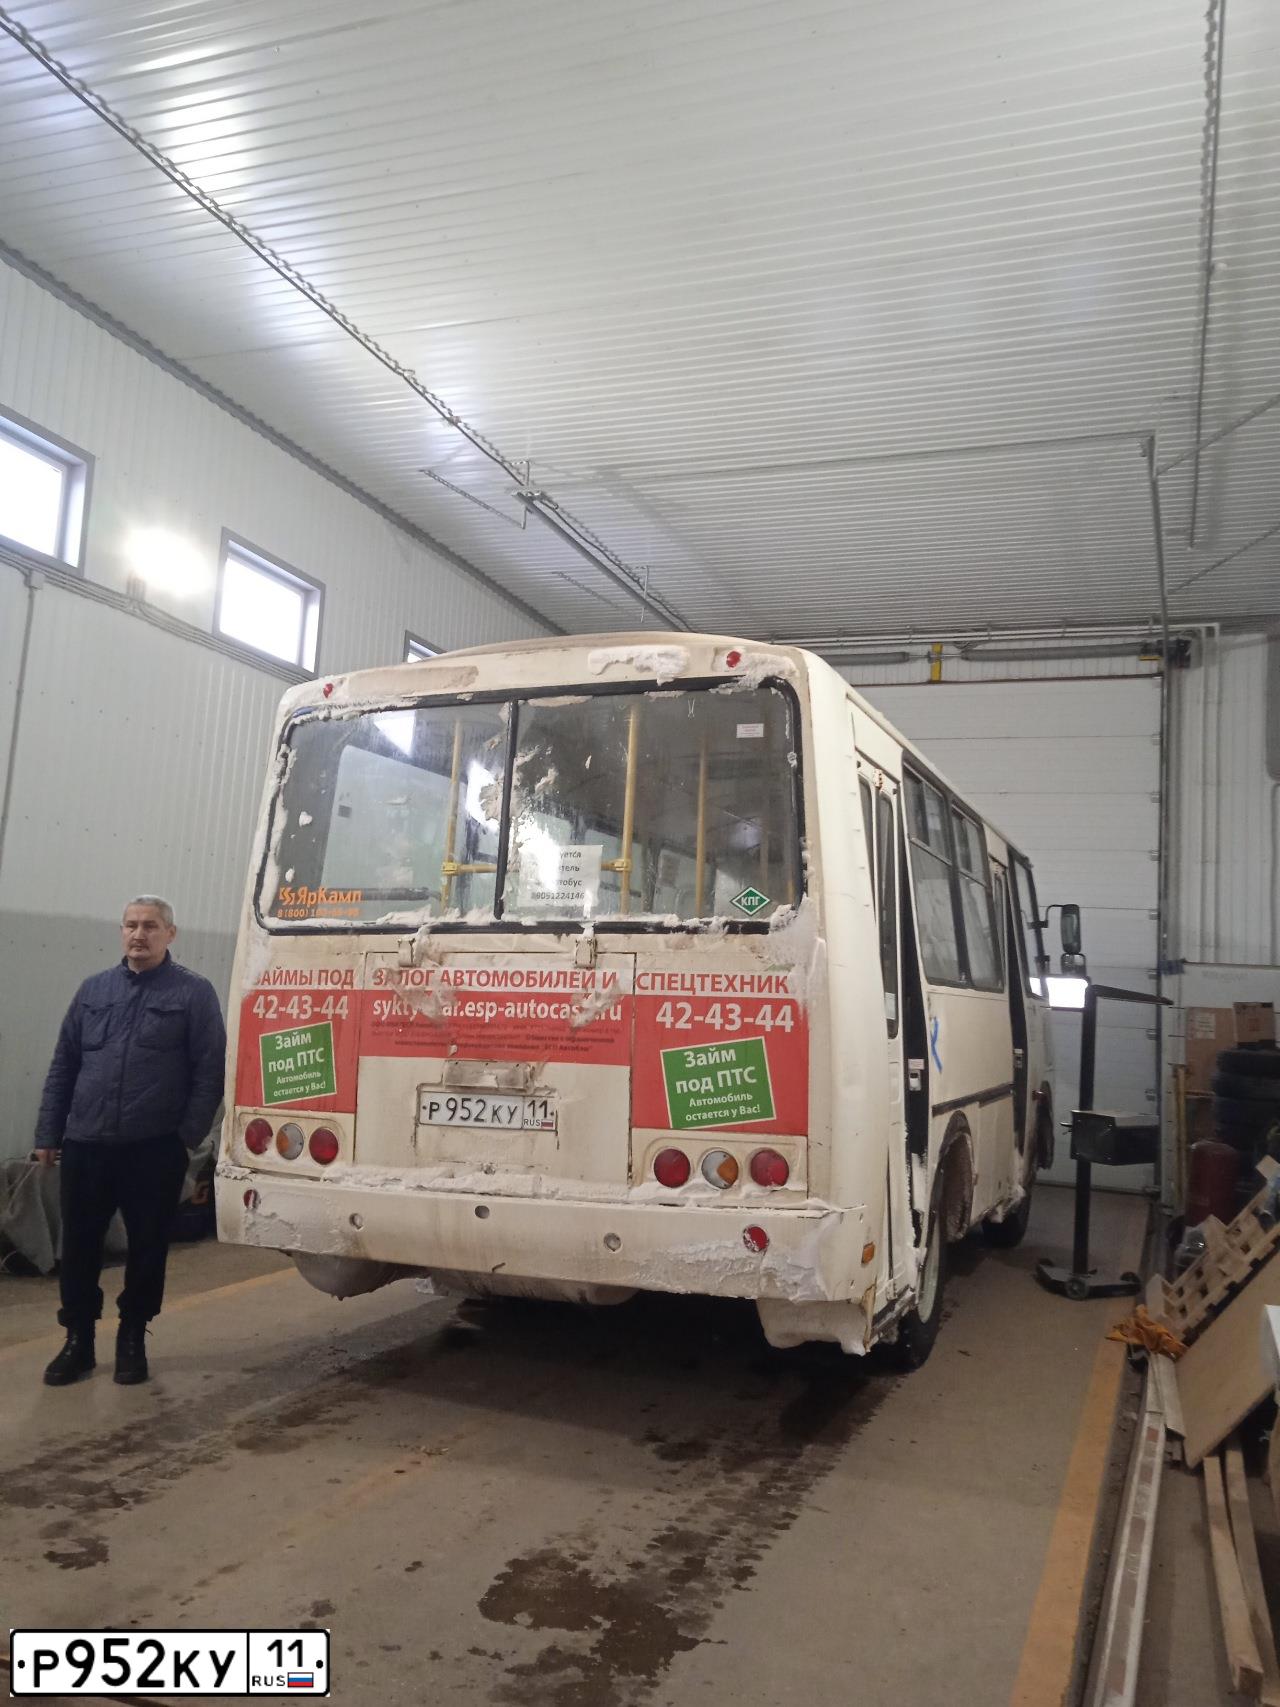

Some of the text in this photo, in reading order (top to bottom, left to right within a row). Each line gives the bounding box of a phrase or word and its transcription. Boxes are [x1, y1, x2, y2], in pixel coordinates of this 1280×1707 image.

[297, 886, 362, 907] ЯрКамп
[741, 896, 760, 906] КПГ
[256, 966, 354, 989] АЙМЫ ПОД
[372, 967, 617, 989] ЗЛОГ АВТОМОБИЛЕЙ И
[252, 995, 349, 1020] 42-43-44
[655, 1001, 795, 1033] 42-43-44
[275, 1031, 312, 1050] Займ
[268, 1047, 325, 1073] под ПТС
[683, 1047, 737, 1068] Займ
[276, 1071, 322, 1085] Автомобиль
[675, 1066, 757, 1094] под ПТС
[273, 1084, 304, 1097] остается
[311, 1081, 326, 1090] Вас!
[689, 1092, 753, 1107] Автомобиль
[428, 1097, 548, 1124] Р952КУ 11
[685, 1104, 760, 1122] остается у Вас!
[523, 1119, 541, 1127] RUS
